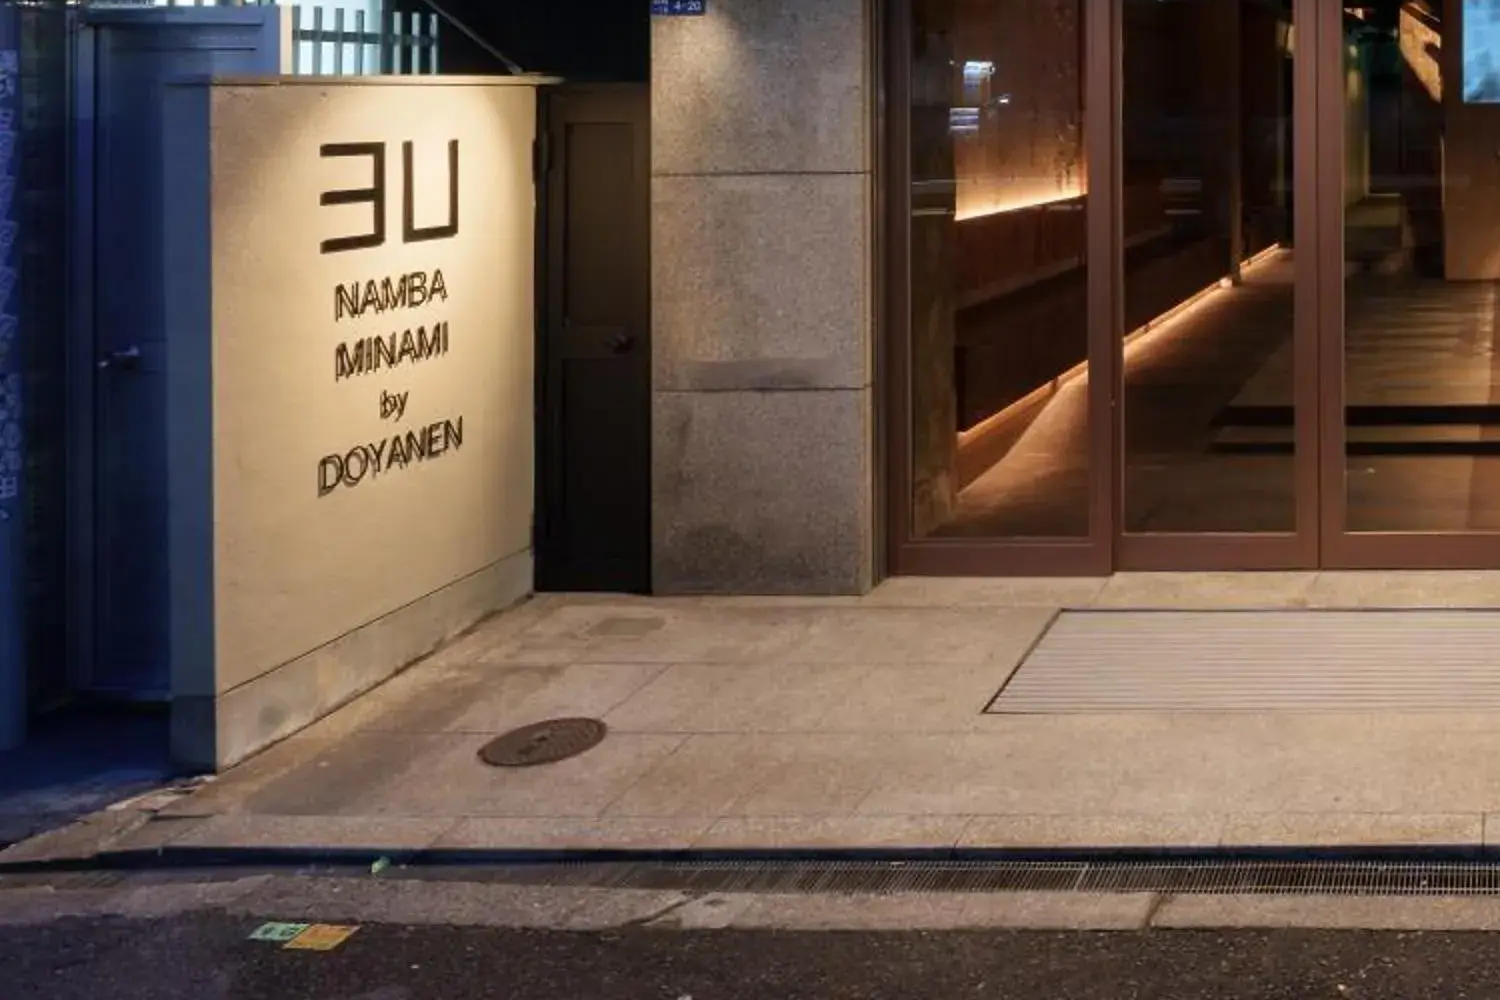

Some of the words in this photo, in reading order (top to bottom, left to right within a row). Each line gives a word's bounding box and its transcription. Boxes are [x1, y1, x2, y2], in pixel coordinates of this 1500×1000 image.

[319, 138, 459, 255] 3U
[334, 267, 449, 322] NAMBA
[334, 320, 449, 383] MINAMI
[379, 389, 409, 422] by
[317, 415, 463, 498] DOYANEN
